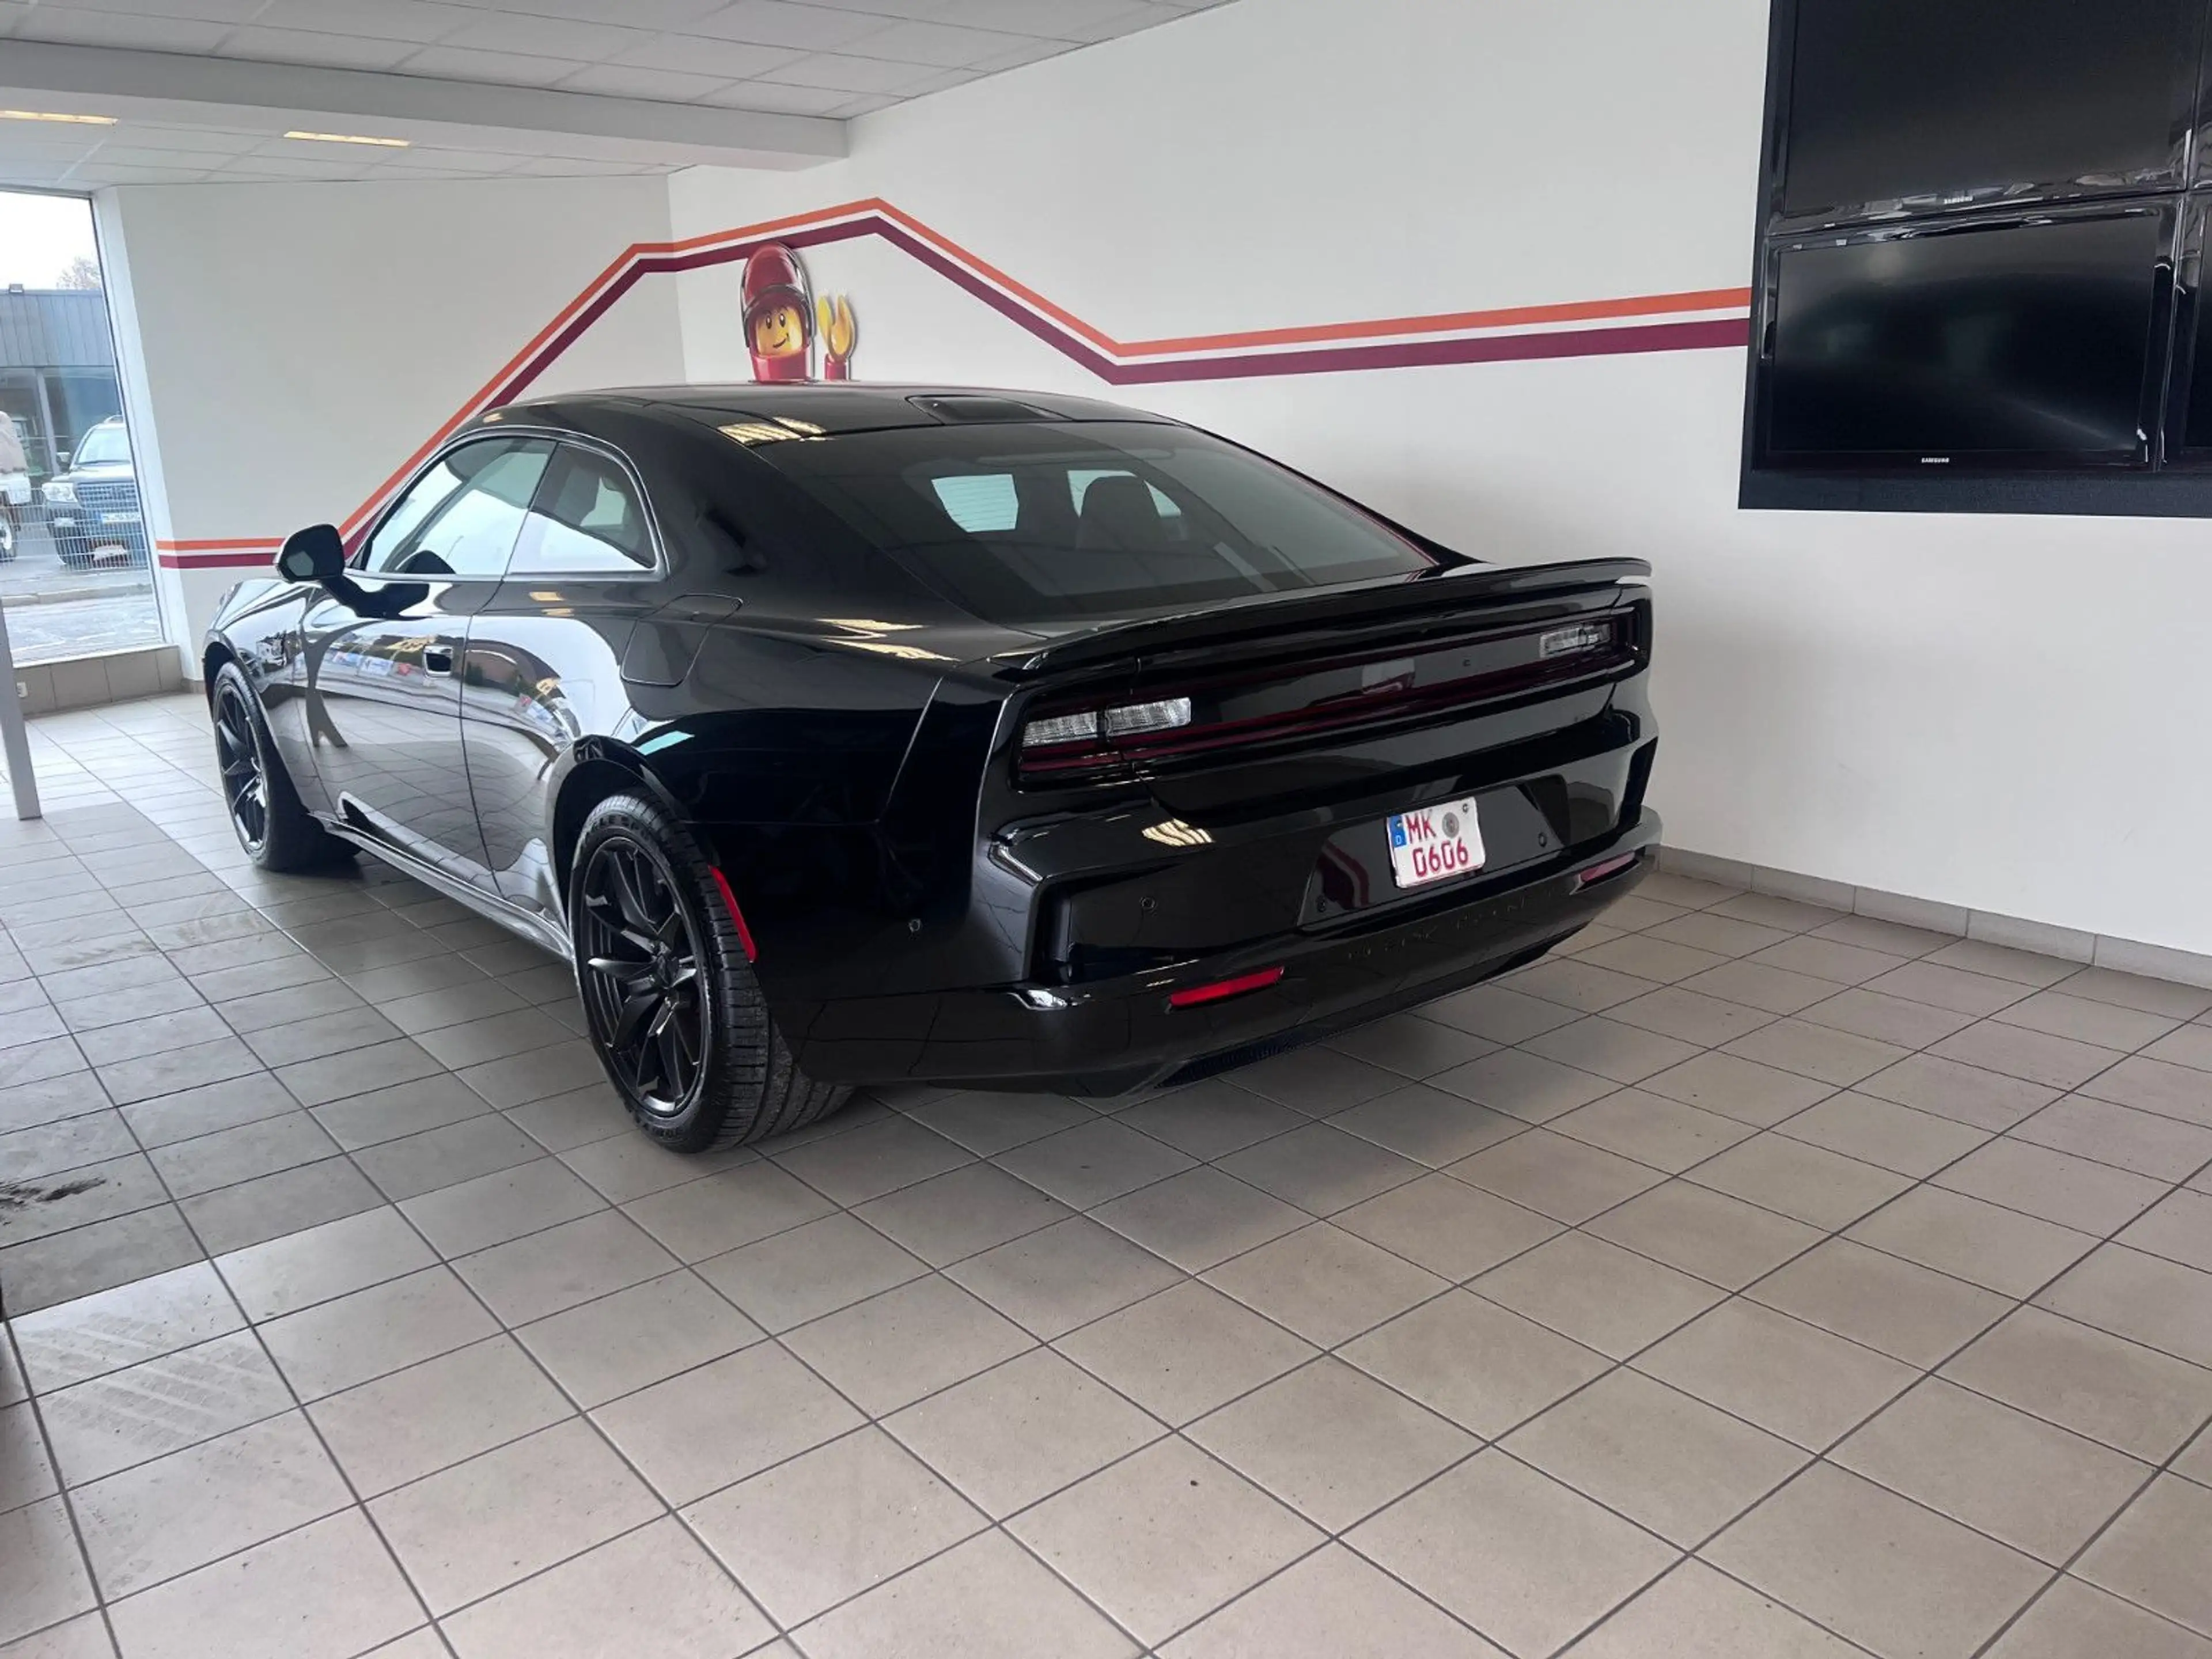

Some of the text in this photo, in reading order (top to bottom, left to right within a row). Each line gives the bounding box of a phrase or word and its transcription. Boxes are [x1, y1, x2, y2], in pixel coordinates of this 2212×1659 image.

[1395, 835, 1402, 845] D
[1405, 809, 1437, 844] MK
[1412, 836, 1468, 877] 0606
